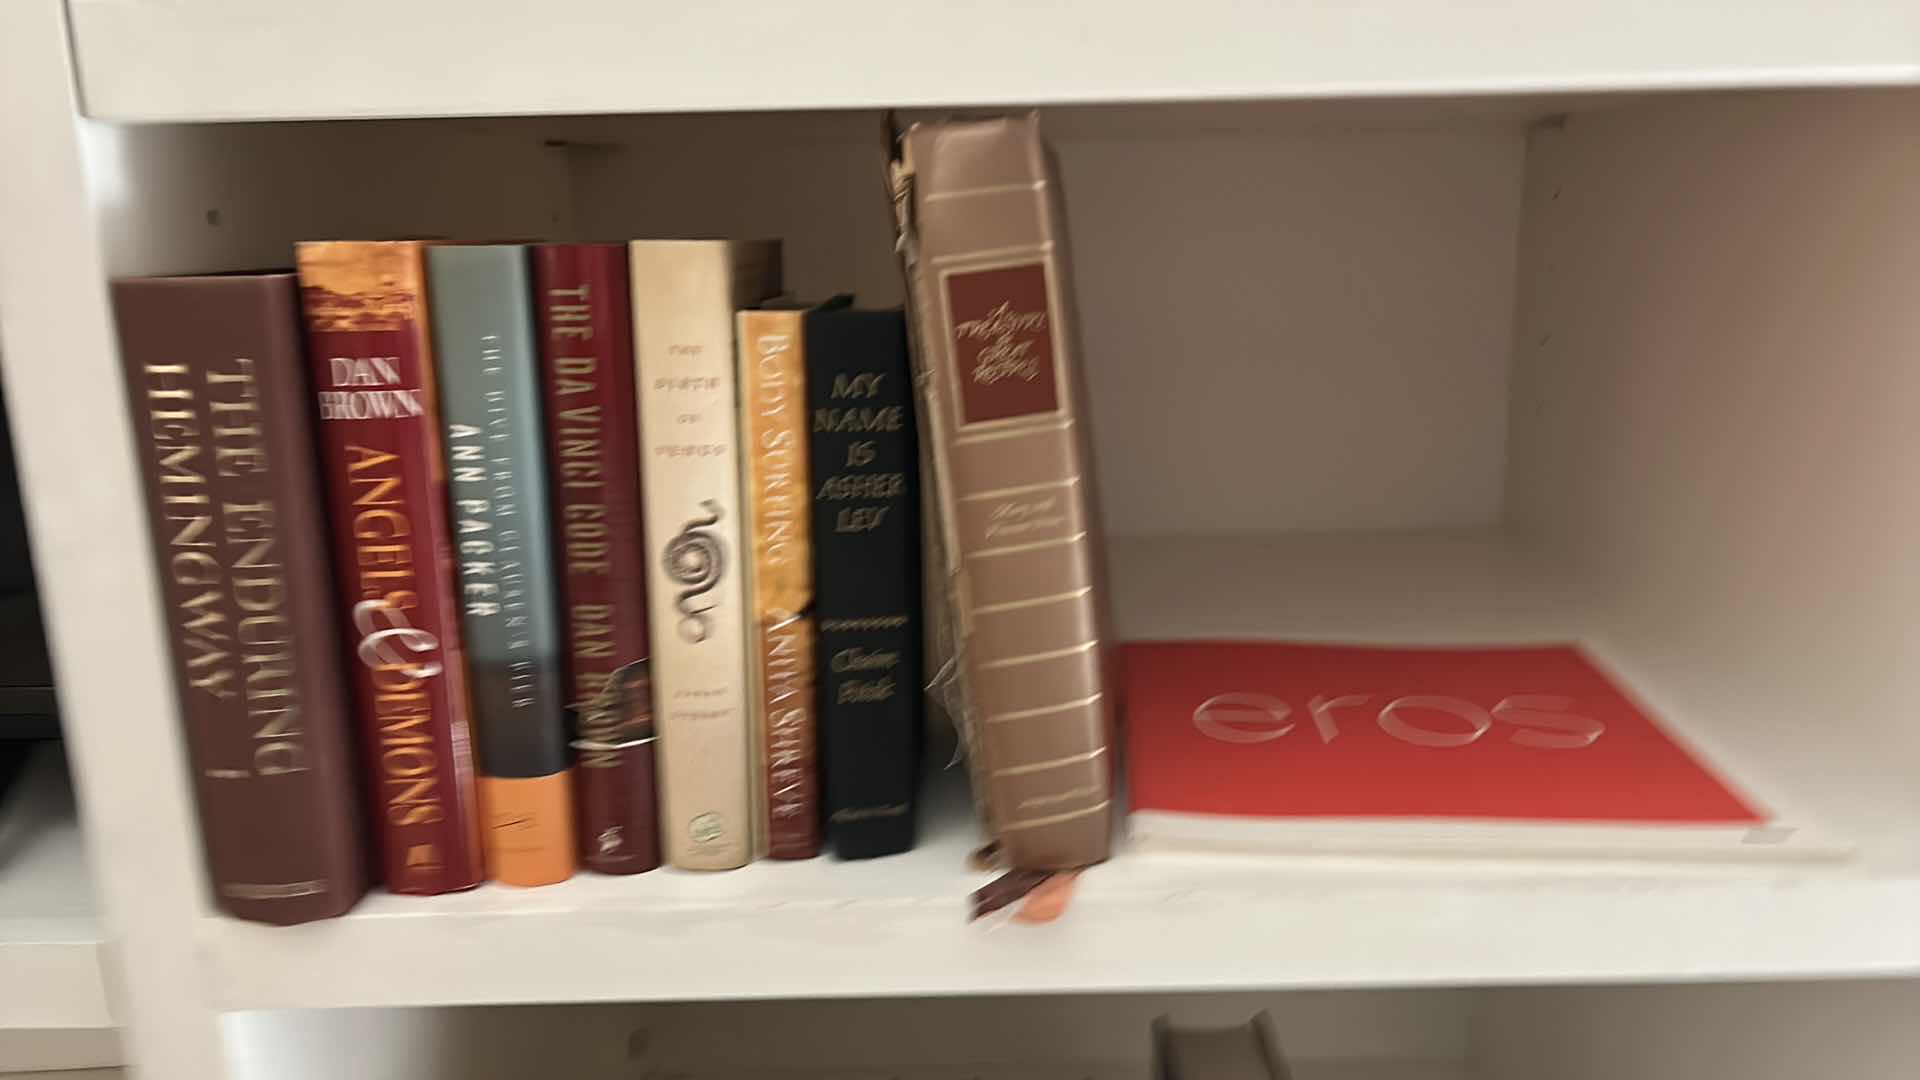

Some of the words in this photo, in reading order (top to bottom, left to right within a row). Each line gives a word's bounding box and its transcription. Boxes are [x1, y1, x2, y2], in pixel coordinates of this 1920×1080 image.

[548, 283, 594, 341] THE
[318, 388, 425, 420] BROWN
[328, 357, 401, 387] DAN
[553, 357, 598, 397] DA
[757, 334, 791, 417] BODY
[830, 371, 889, 400] MY
[206, 357, 269, 480] THE
[448, 423, 488, 482] ANN
[558, 404, 608, 489] VINCI
[813, 405, 905, 433] NAME
[846, 439, 878, 468] IS
[143, 362, 237, 699] HEMINGWAY
[344, 444, 419, 611] ANGELS
[760, 428, 795, 566] SURFING
[456, 498, 501, 617] PACKER
[563, 502, 612, 576] CODE
[222, 500, 310, 777] ENDURING
[353, 599, 443, 679] &
[571, 603, 617, 659] DAN
[766, 606, 804, 705] ANITA
[371, 661, 445, 827] DEMONS
[574, 671, 626, 769] BROWN
[1192, 691, 1606, 749] eros
[768, 706, 808, 822] SHREVE
